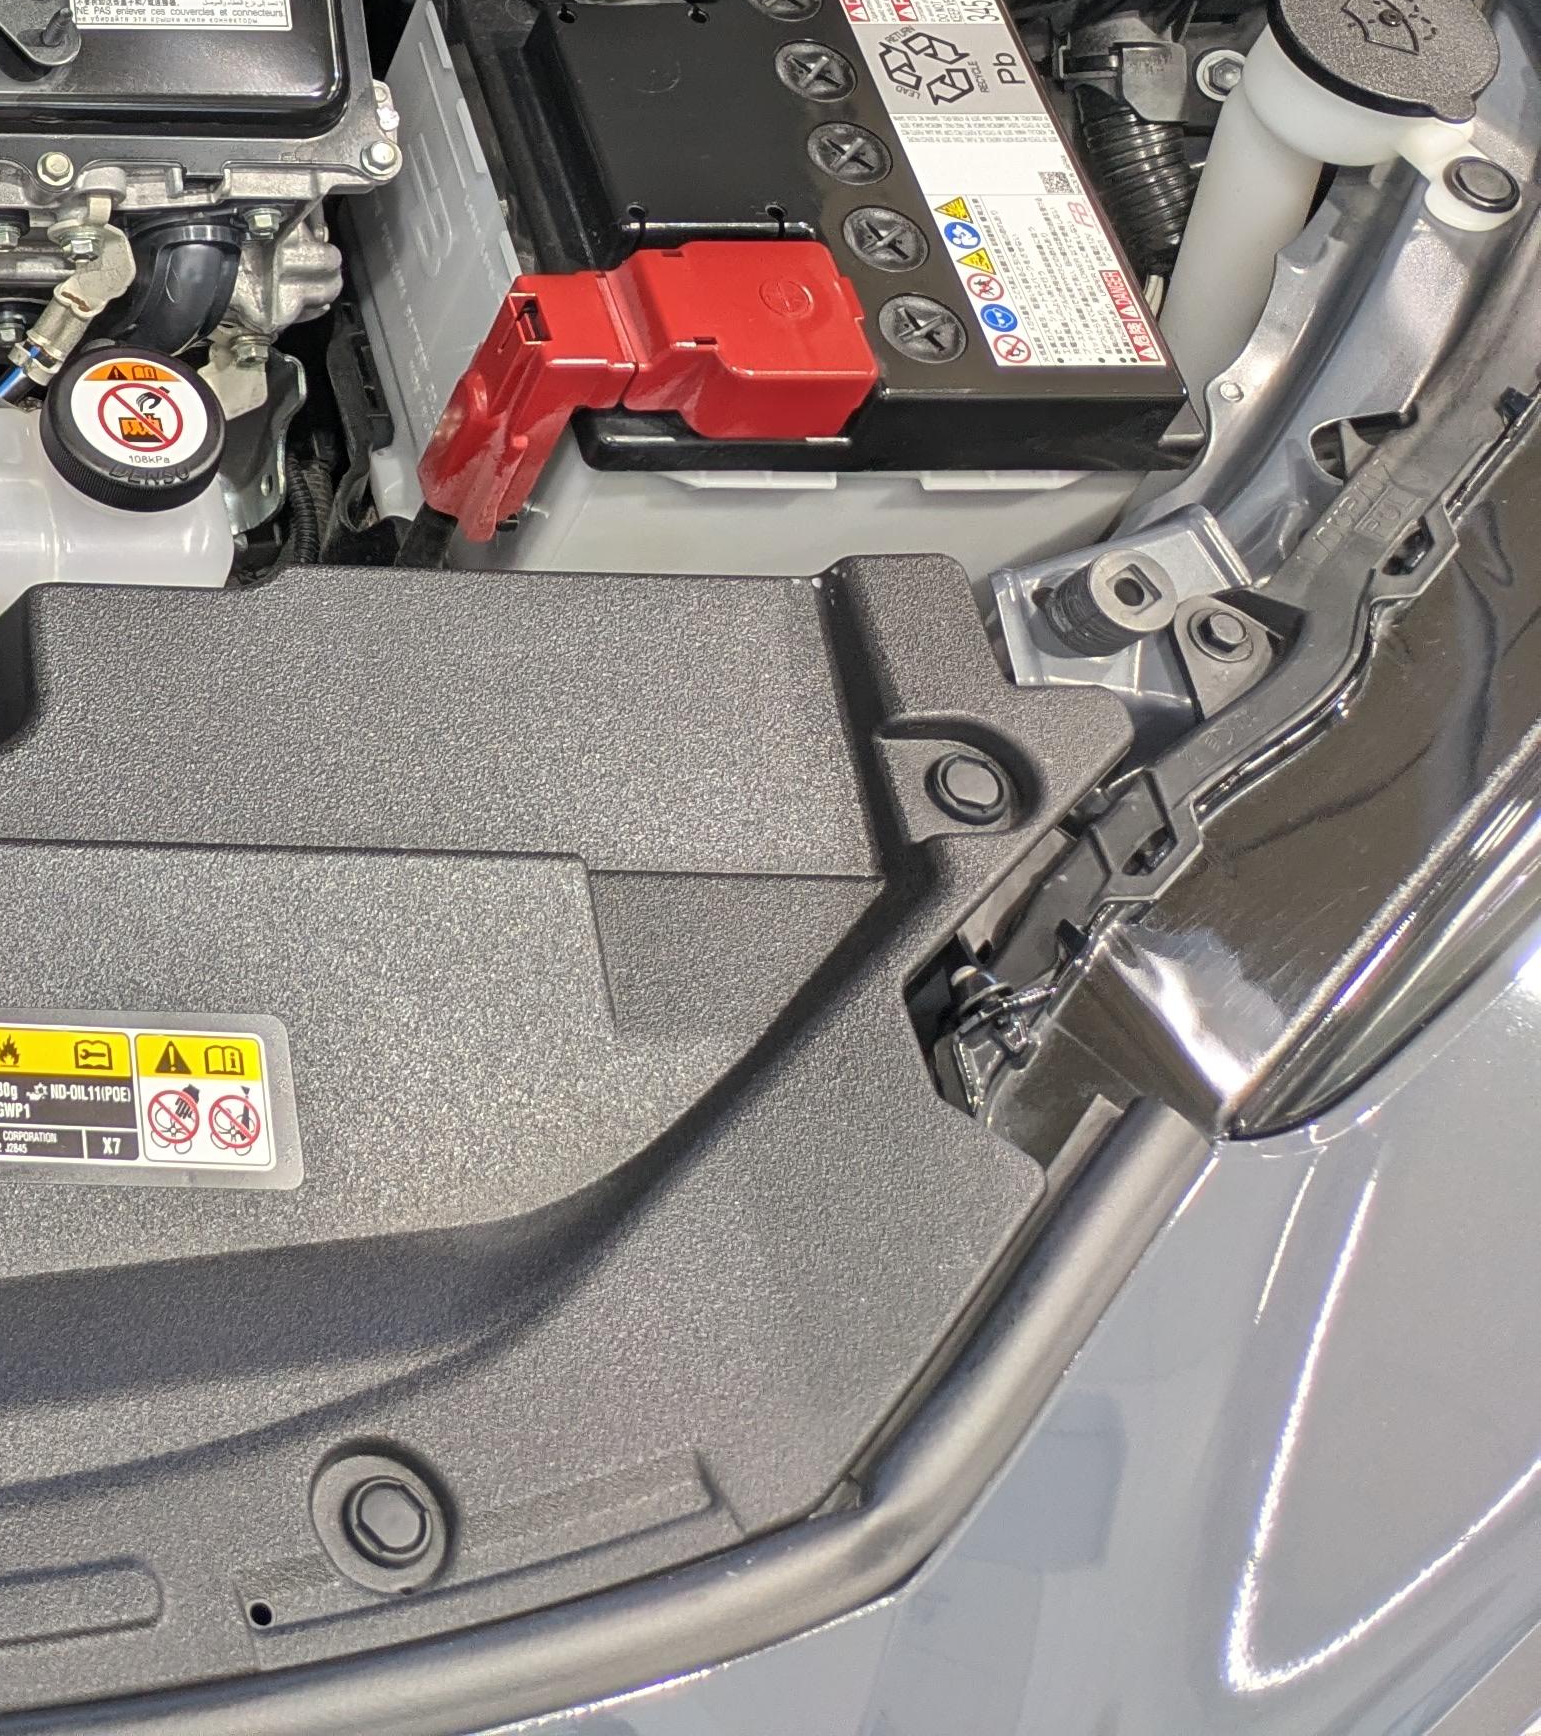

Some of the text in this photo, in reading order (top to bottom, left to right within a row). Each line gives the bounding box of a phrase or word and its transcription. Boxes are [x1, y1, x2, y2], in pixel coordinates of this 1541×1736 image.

[76, 7, 89, 15] NE
[93, 7, 112, 15] PAS
[885, 26, 915, 44] RETURN
[992, 52, 1026, 83] Pb
[967, 61, 990, 93] RECYCLE
[895, 85, 920, 99] LEAD
[1101, 271, 1133, 305] DANGER
[129, 455, 170, 464] 108kPa
[109, 465, 190, 485] DENSO
[50, 1084, 131, 1102] ND-OIL11(POE)
[2, 1130, 57, 1143] CORPORATION
[5, 1143, 28, 1154] J2845
[103, 1137, 122, 1155] X7
